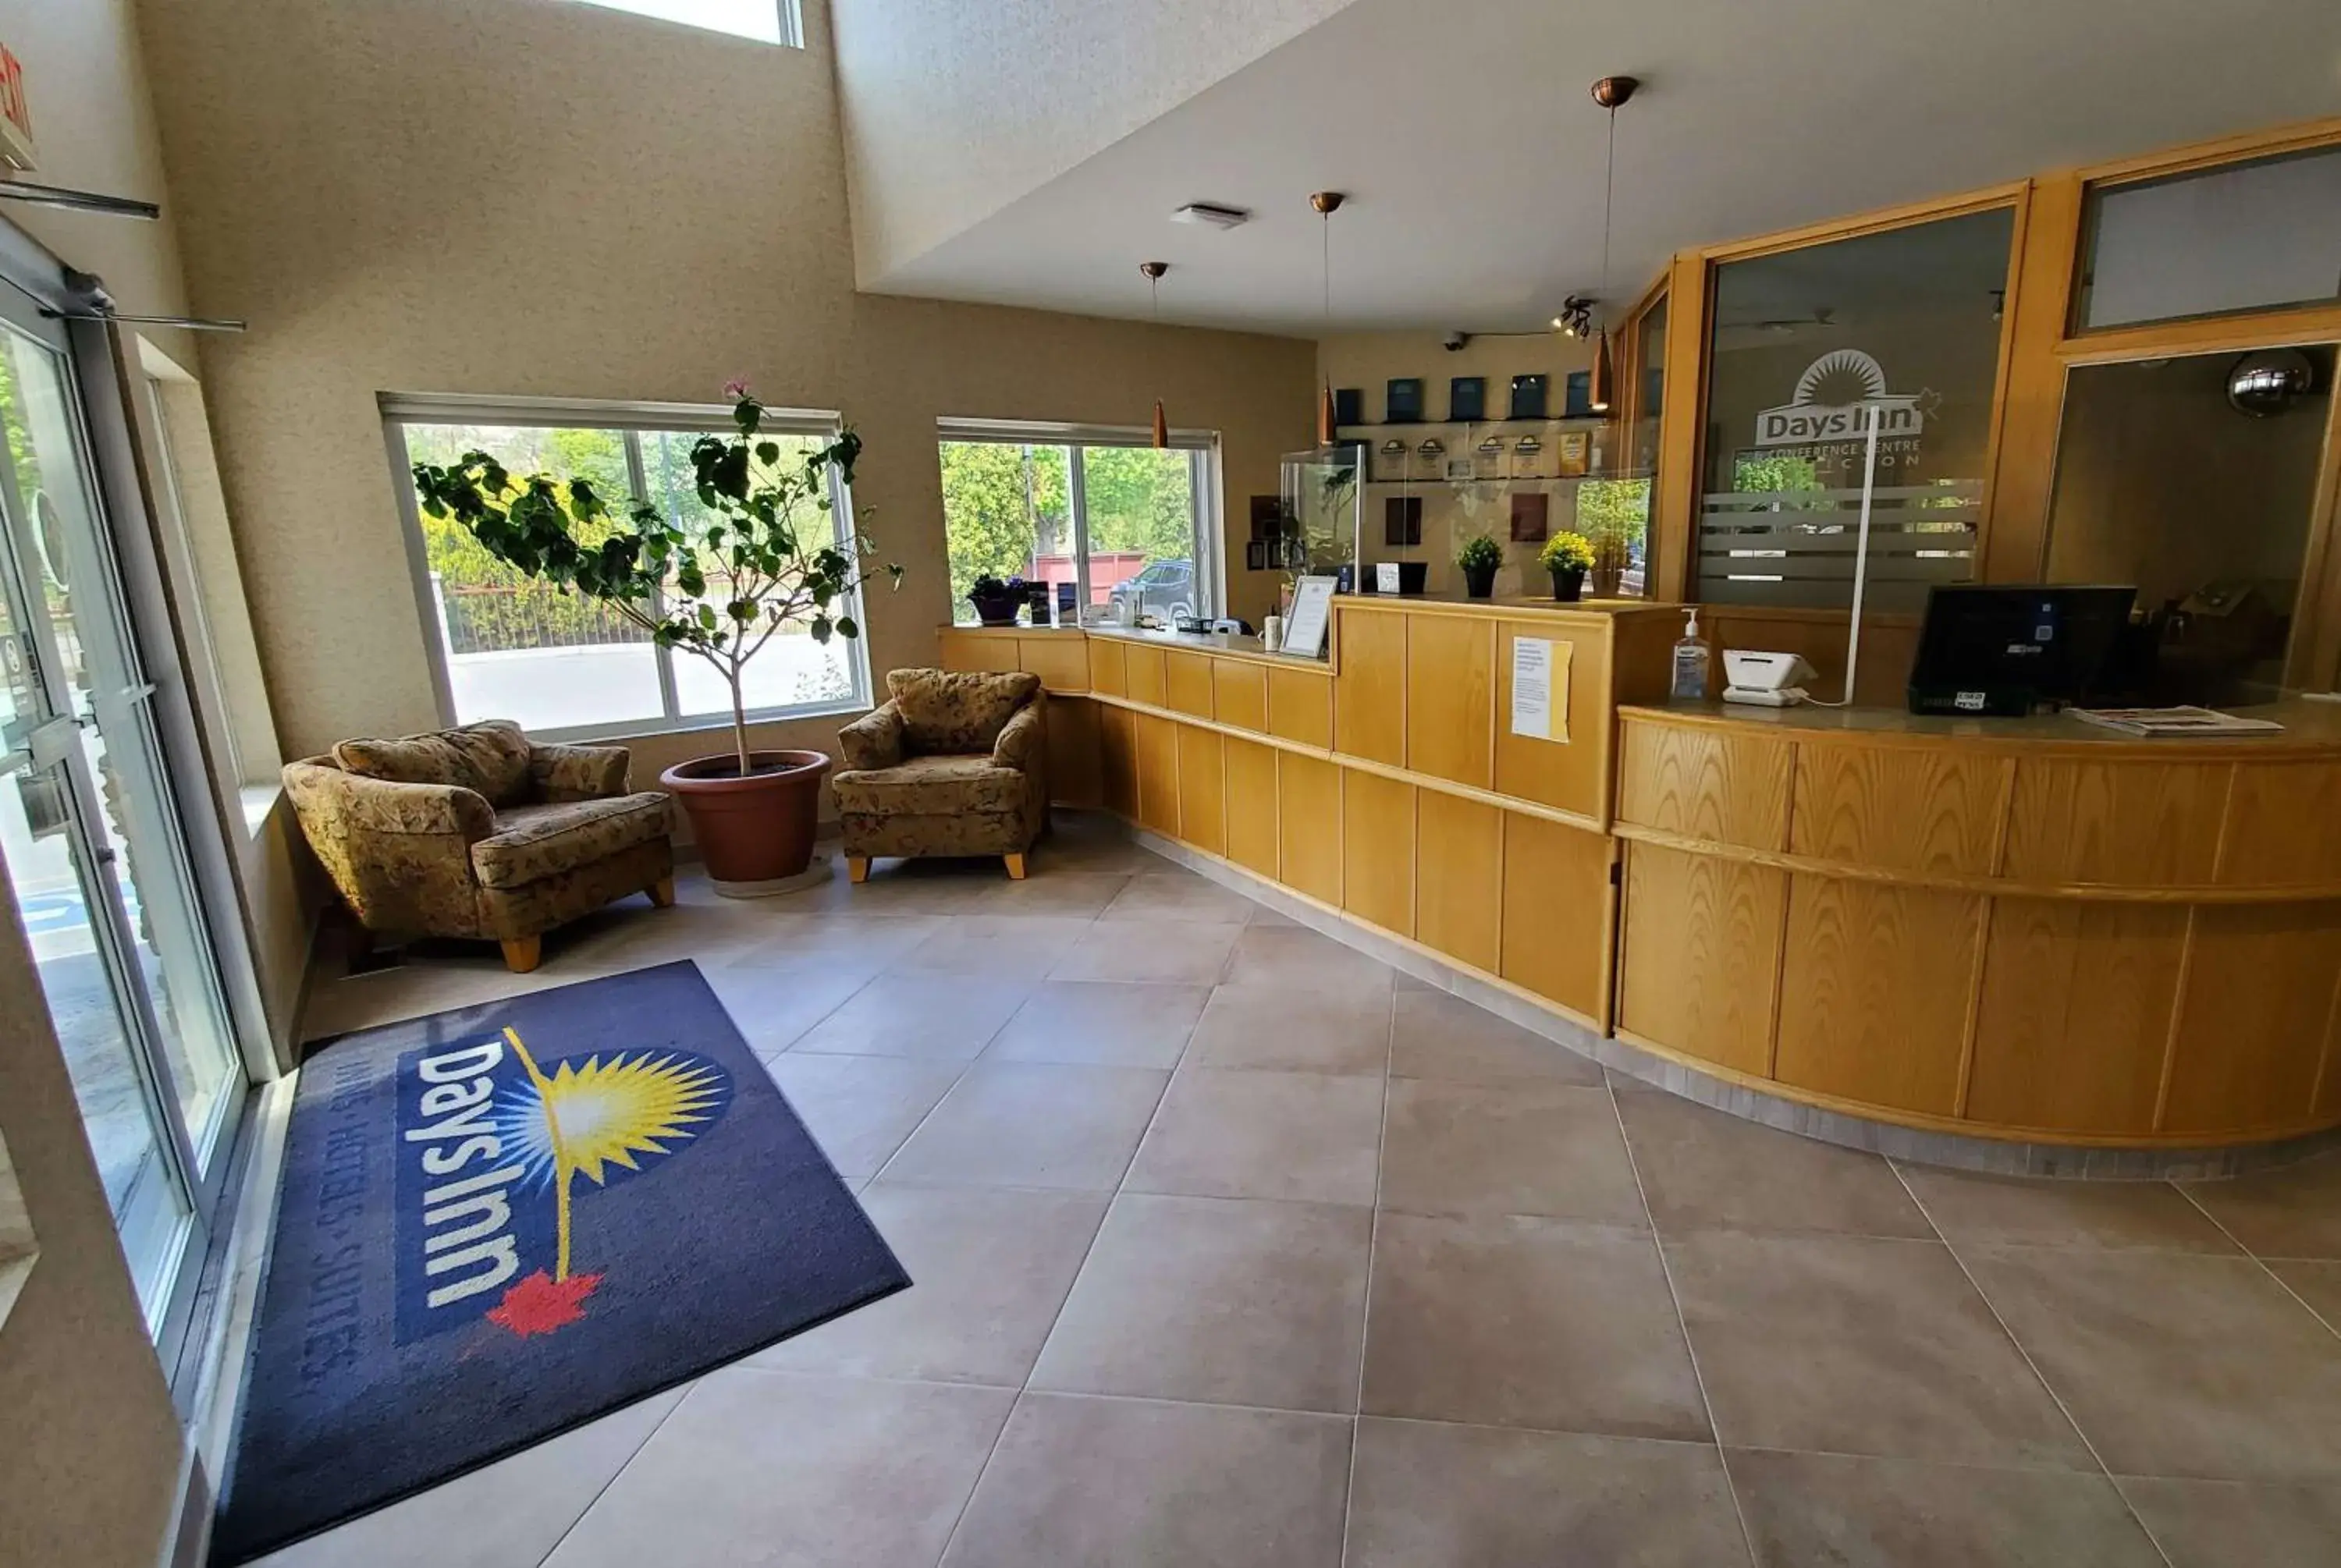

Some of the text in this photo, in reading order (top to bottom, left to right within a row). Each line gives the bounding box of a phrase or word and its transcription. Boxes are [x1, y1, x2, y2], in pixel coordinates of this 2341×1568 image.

[1767, 408, 1911, 438] Days Inn
[405, 1041, 526, 1309] Days Inn
